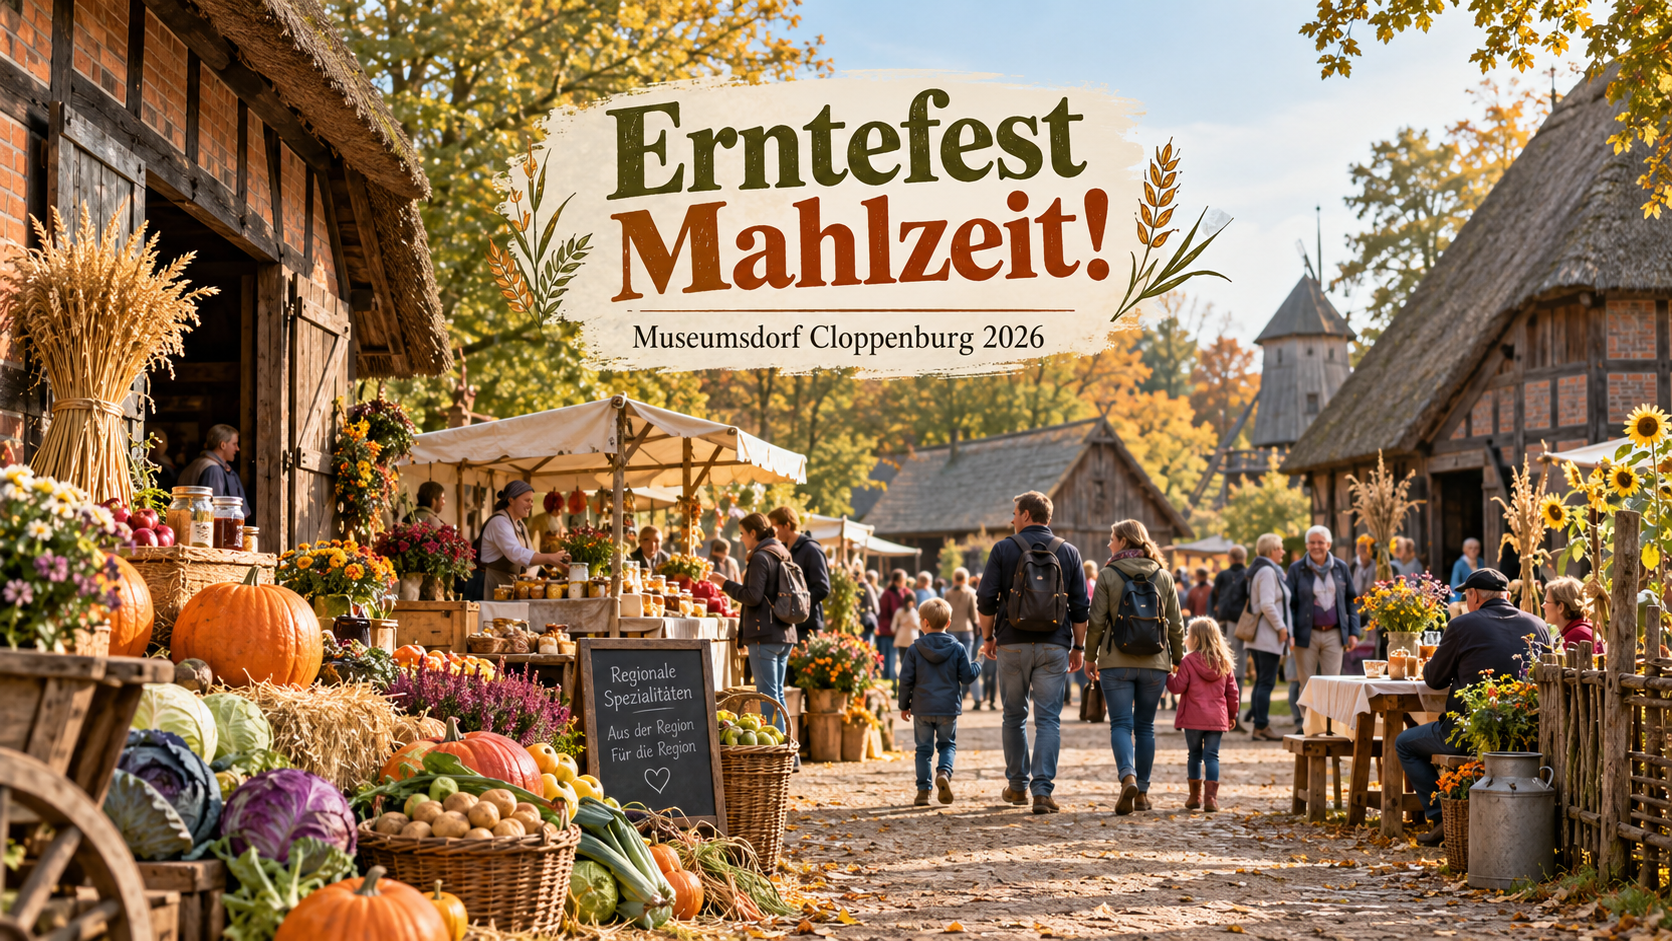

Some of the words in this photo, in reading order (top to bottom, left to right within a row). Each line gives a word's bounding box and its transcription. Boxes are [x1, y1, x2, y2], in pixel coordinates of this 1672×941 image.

[610, 662, 677, 687] Regionale
[604, 686, 693, 712] Spezialitäten
[607, 725, 630, 741] Aus
[634, 722, 652, 738] der
[656, 718, 695, 738] Region
[611, 747, 632, 763] Für
[636, 745, 654, 760] die
[657, 740, 697, 760] Region
